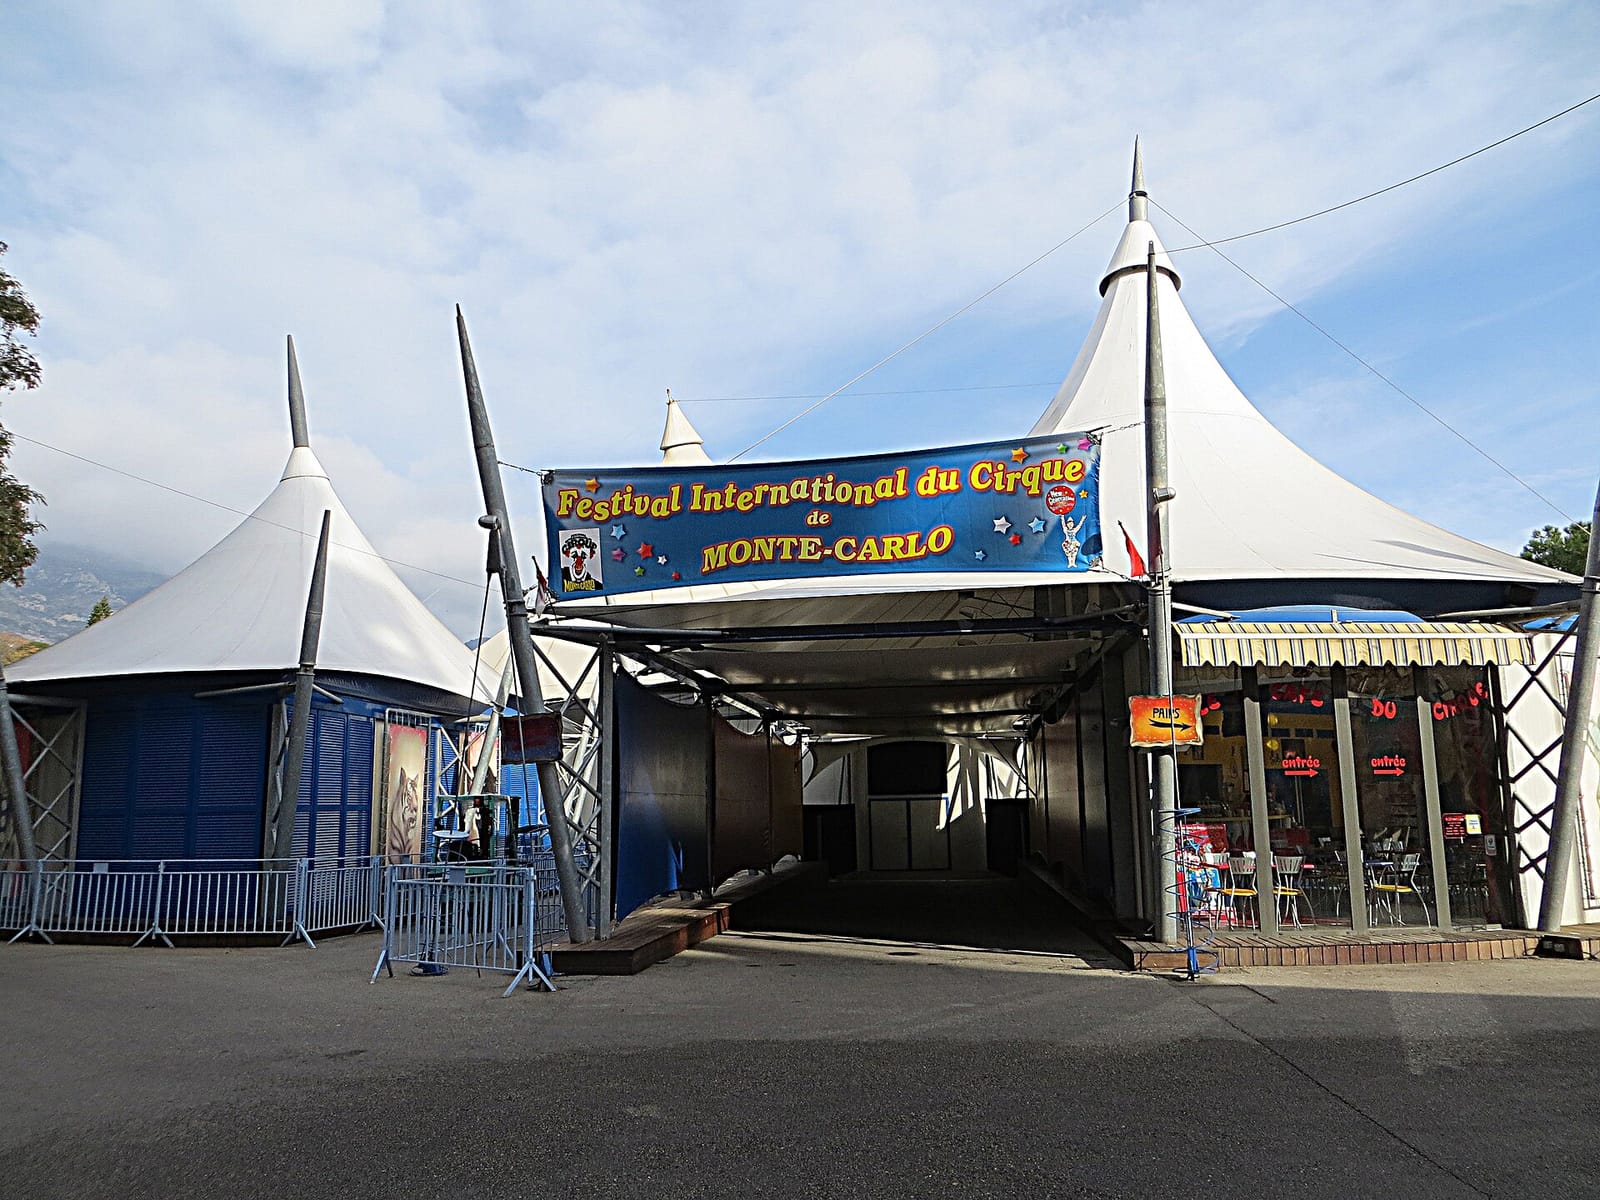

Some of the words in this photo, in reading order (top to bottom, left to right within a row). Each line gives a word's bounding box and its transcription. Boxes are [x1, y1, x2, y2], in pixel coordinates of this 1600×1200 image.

[557, 483, 682, 522] Festival
[690, 466, 908, 514] International
[917, 466, 960, 497] du
[970, 457, 1085, 496] Cirque
[806, 510, 832, 526] de
[701, 525, 953, 574] MONTE-CARLO
[1371, 698, 1397, 720] DU
[1282, 755, 1321, 769] entrée
[1371, 754, 1406, 768] entrée
